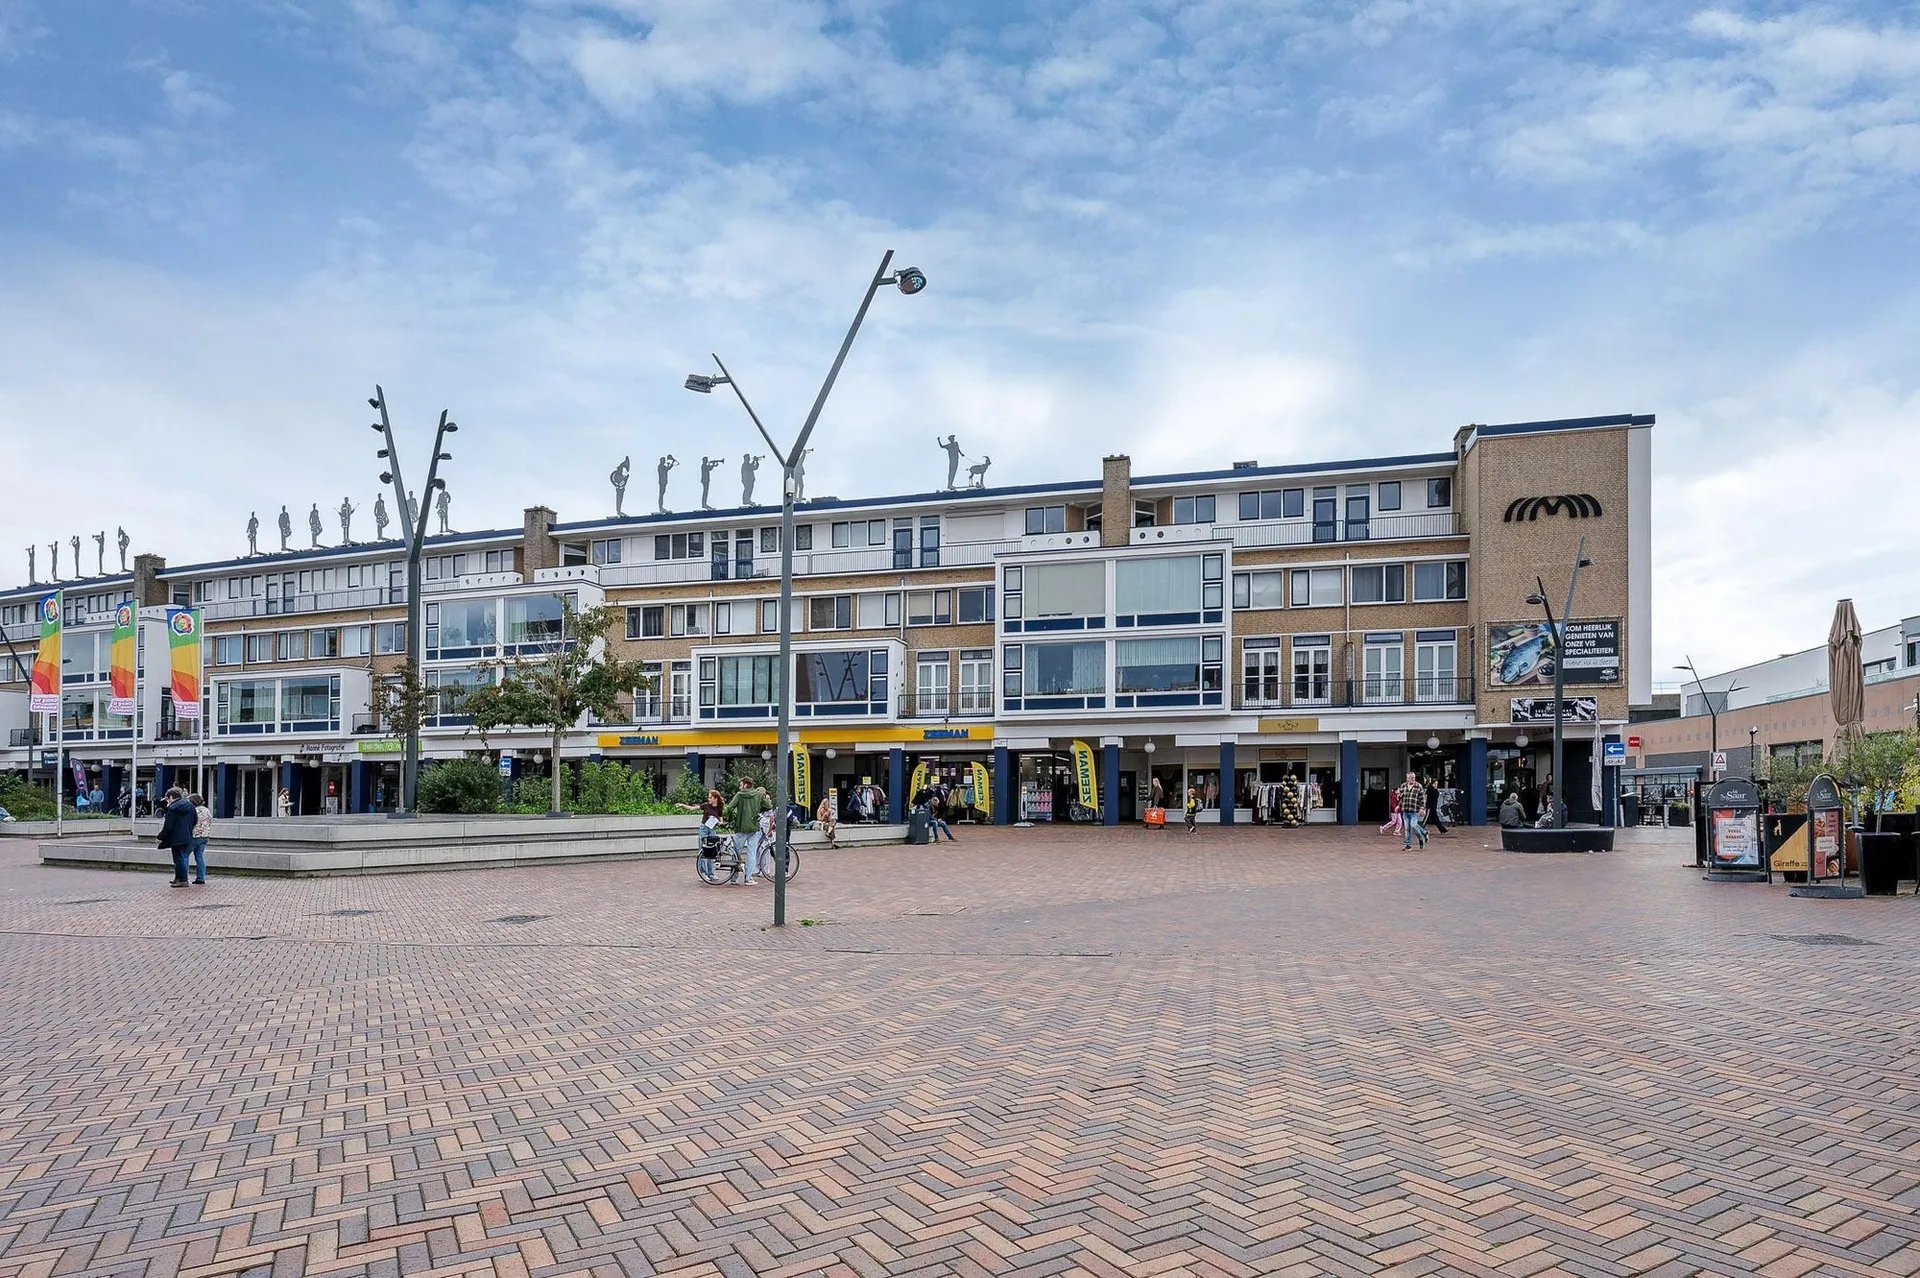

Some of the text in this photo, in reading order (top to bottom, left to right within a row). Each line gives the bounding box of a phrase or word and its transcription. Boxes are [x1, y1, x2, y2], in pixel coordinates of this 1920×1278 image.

[1565, 631, 1614, 640] GENIETEN VAN
[1565, 647, 1614, 656] SPECIALITEITEN
[923, 729, 969, 740] ZEEMAN
[619, 735, 659, 745] ZEEMAN
